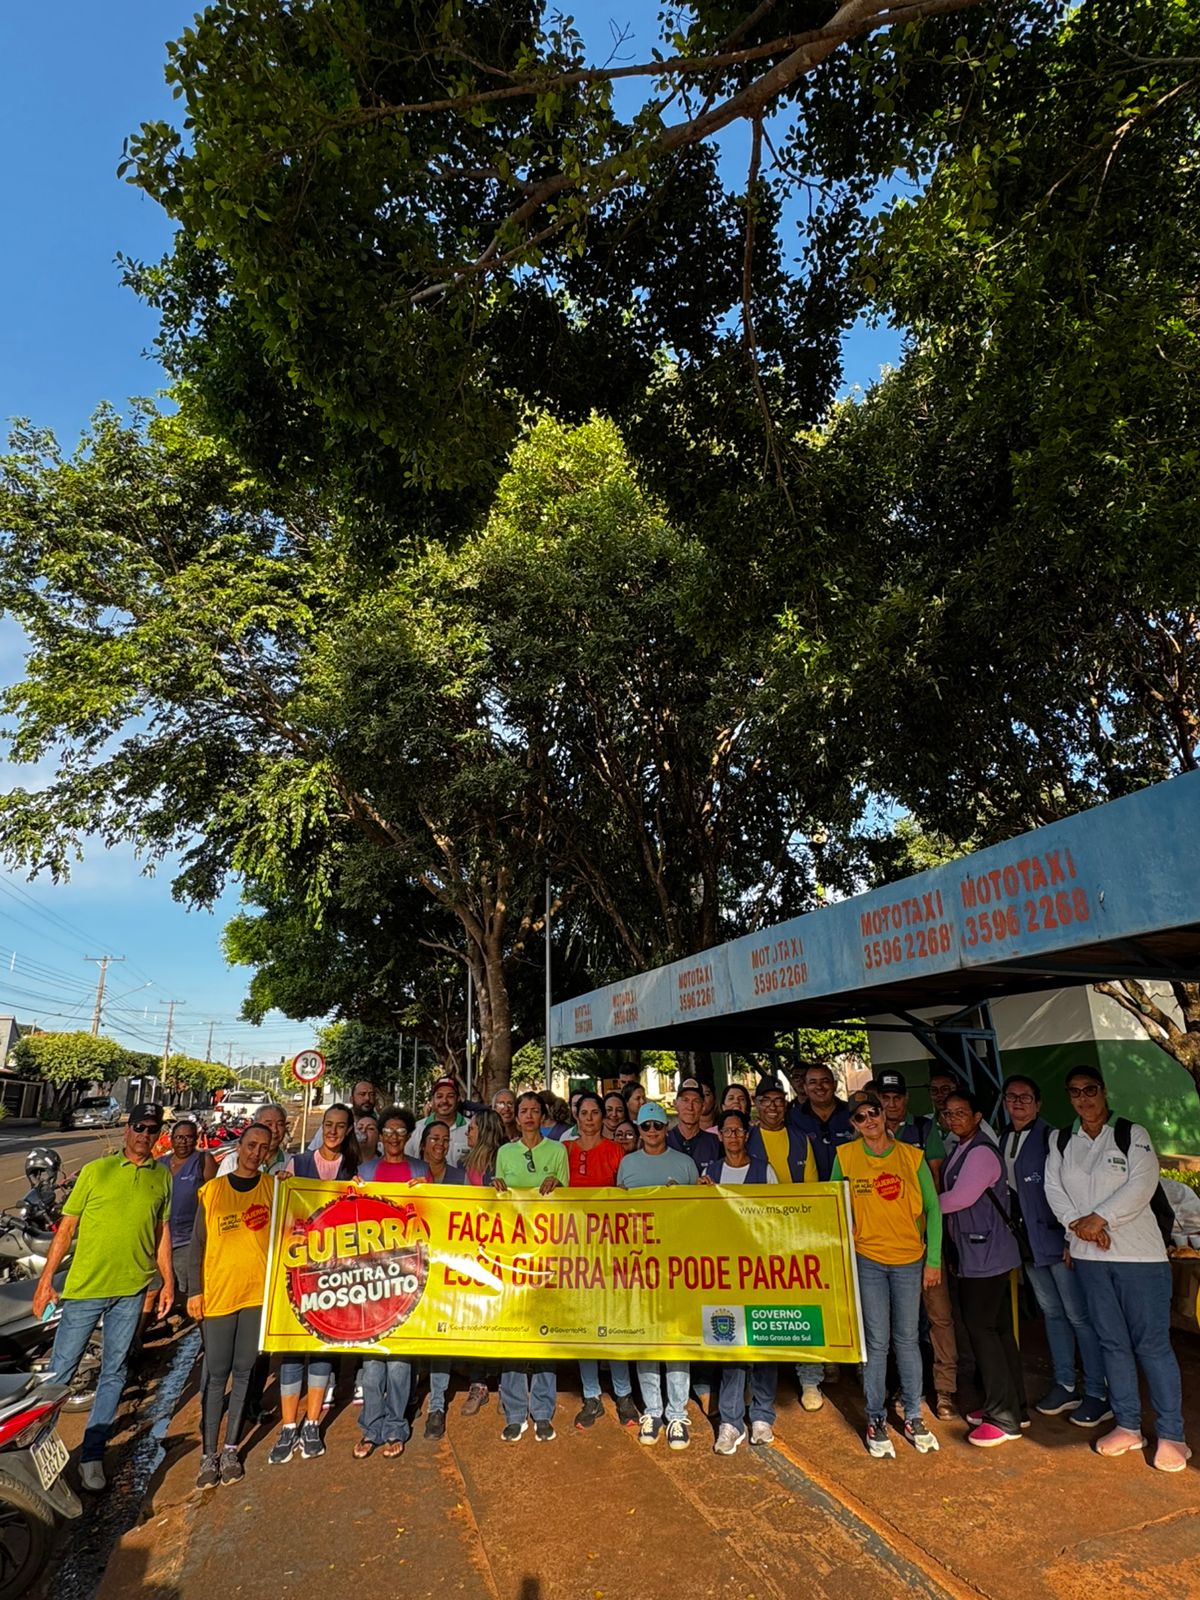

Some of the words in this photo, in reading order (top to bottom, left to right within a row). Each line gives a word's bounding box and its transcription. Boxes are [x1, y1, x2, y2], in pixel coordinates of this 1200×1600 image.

[961, 848, 1077, 909] MOTOTAXI
[860, 889, 944, 937] MOTOTAXI
[965, 905, 1021, 949] 3596
[1024, 887, 1090, 933] 2268
[863, 935, 902, 970] 3596
[904, 923, 951, 960] 2268
[678, 963, 713, 989] MOTOTAXI
[754, 969, 779, 995] 3596
[779, 962, 808, 989] 2268
[680, 991, 696, 1012] 3596
[302, 1057, 317, 1069] 30
[739, 1204, 812, 1216] www.ms.gov.br
[283, 1216, 430, 1268] GUERRA
[447, 1211, 505, 1251] FAÇA
[511, 1213, 527, 1245] A
[534, 1212, 579, 1245] SUA
[586, 1212, 662, 1245] PARTE.
[318, 1265, 386, 1289] CONTRA
[388, 1262, 400, 1276] O
[511, 1255, 606, 1289] GUERRA
[612, 1249, 660, 1290] NÃO
[668, 1256, 732, 1290] PODE
[738, 1254, 831, 1290] PARAR.
[300, 1274, 419, 1314] MOSQUITO
[751, 1309, 803, 1319] GOVERNO
[752, 1321, 768, 1331] DO
[769, 1321, 811, 1331] ESTADO
